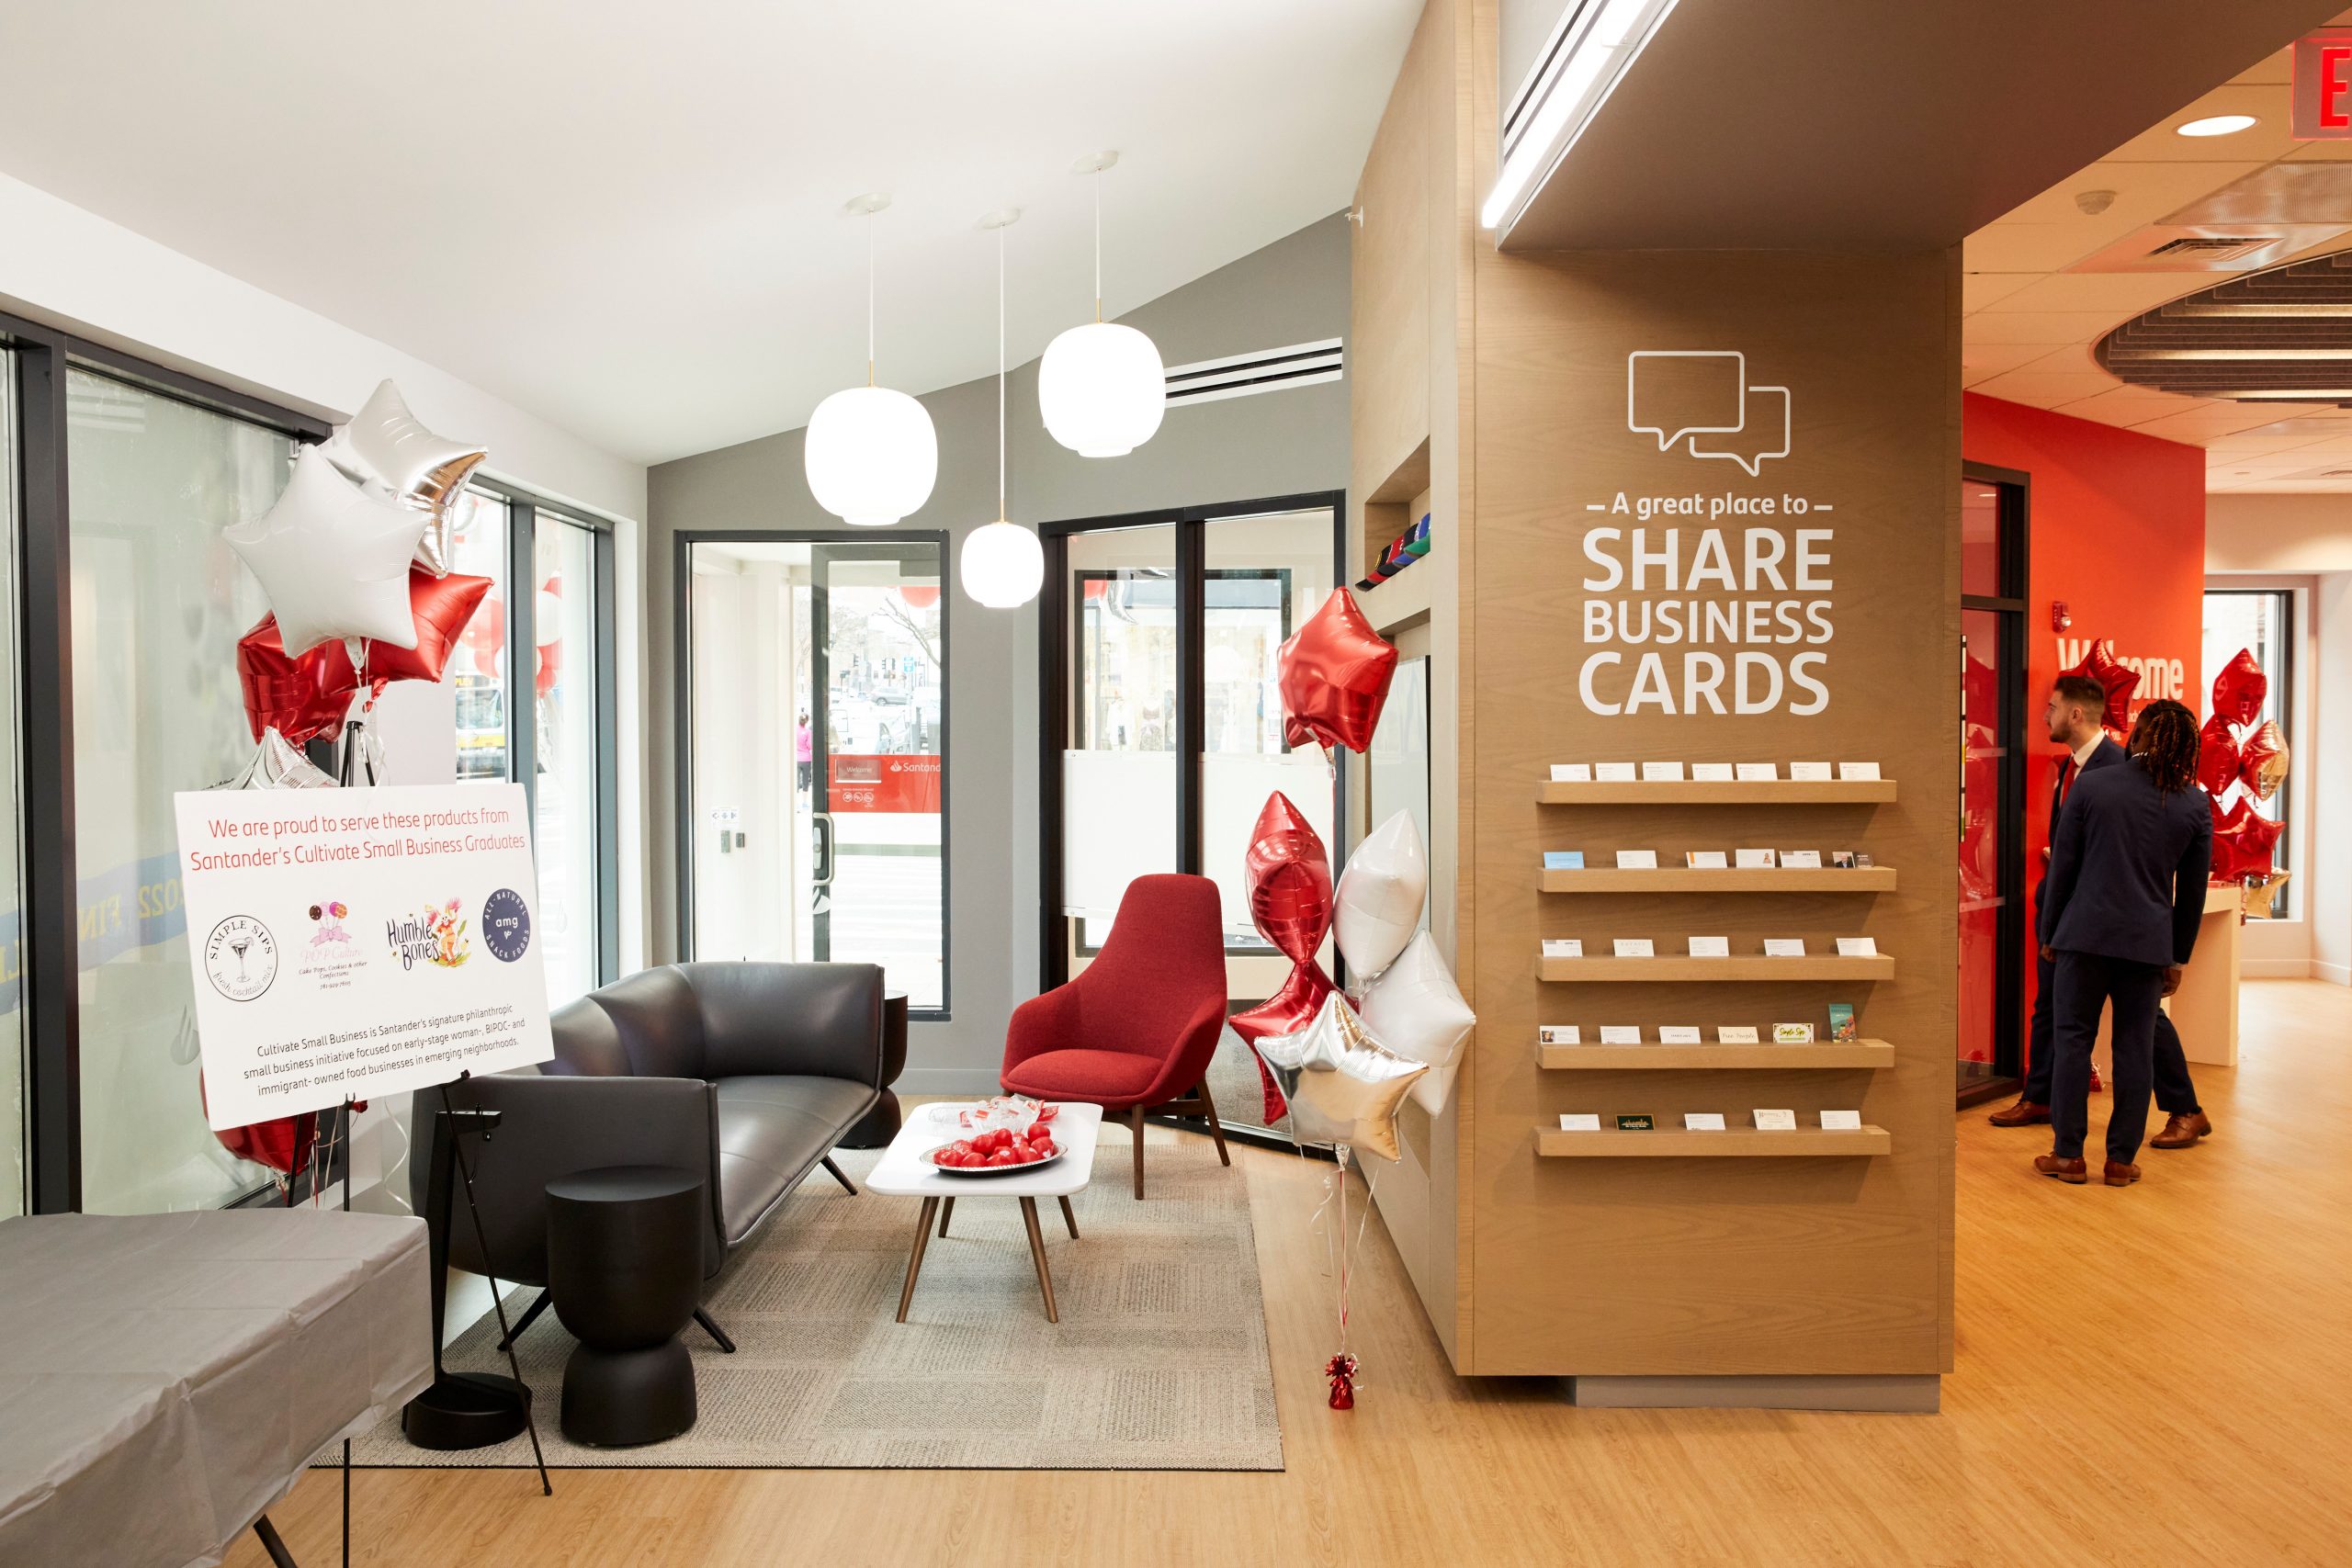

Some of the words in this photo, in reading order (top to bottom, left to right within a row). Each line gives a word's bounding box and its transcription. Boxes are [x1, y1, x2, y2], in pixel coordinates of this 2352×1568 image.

[1611, 492, 1630, 514] A
[1636, 493, 1704, 521] great
[1710, 492, 1776, 521] place
[1783, 493, 1808, 514] to
[1582, 526, 1834, 592] SHARE
[1583, 599, 1834, 644] BUSINESS
[1578, 651, 1830, 716] CARDS
[2056, 637, 2184, 700] Wome
[209, 819, 238, 838] We
[243, 821, 269, 837] are
[274, 816, 319, 840] proud
[322, 816, 337, 832] to
[341, 816, 379, 831] serve
[382, 811, 420, 829] these
[424, 809, 479, 831] products
[481, 807, 509, 824] from
[190, 847, 291, 871] Santander's
[294, 844, 360, 863] Cultivate
[363, 839, 403, 859] Small
[406, 837, 463, 855] Business
[465, 834, 526, 852] Graduates
[484, 891, 526, 919] ALL-NATURAL
[495, 917, 518, 929] amg
[209, 920, 247, 960] SIMPLE
[252, 925, 273, 954] SIPS
[386, 917, 433, 948] Humble
[486, 934, 508, 958] SNACK
[513, 930, 530, 957] FOODS
[401, 940, 439, 971] Bones
[243, 1064, 272, 1079] small
[273, 1058, 314, 1074] business
[316, 1051, 355, 1066] initiative
[356, 1043, 390, 1059] focused
[391, 1043, 402, 1052] on
[404, 1032, 449, 1049] early-stage
[450, 1028, 484, 1040] woman-,
[485, 1021, 511, 1034] BIPOC-
[512, 1018, 526, 1029] and
[257, 1042, 300, 1057] Cultivate
[301, 1034, 328, 1050] Small
[330, 1029, 368, 1044] Business
[369, 1027, 378, 1037] is
[379, 1019, 427, 1036] Santander's
[428, 1012, 465, 1029] signature
[466, 1003, 514, 1022] philanthropic
[257, 1077, 312, 1096] immigrant-
[314, 1070, 345, 1085] owned
[346, 1066, 367, 1078] food
[368, 1057, 414, 1075] businesses
[415, 1055, 424, 1066] in
[424, 1048, 462, 1062] emerging
[463, 1036, 519, 1056] neighborhoods.
